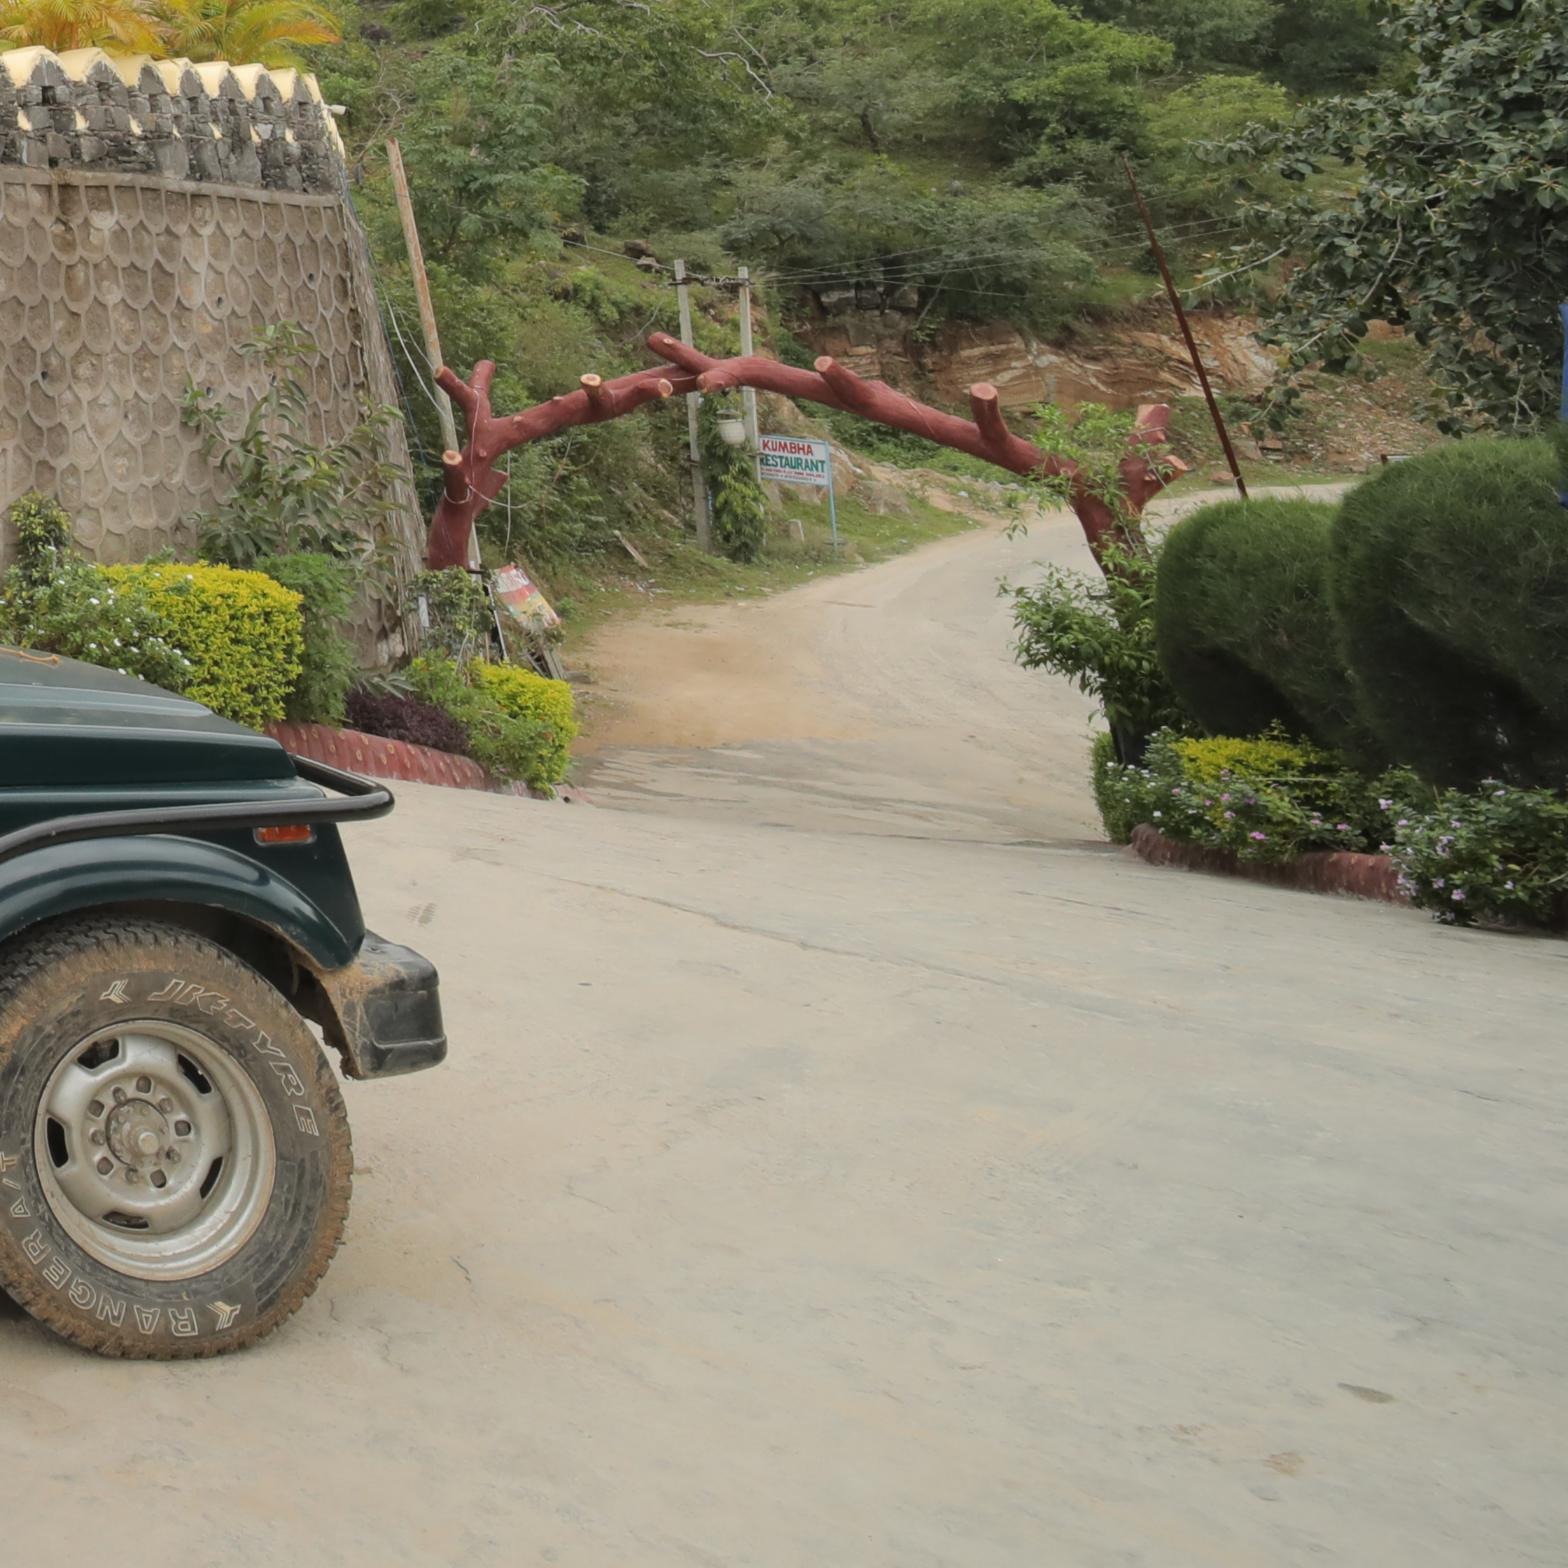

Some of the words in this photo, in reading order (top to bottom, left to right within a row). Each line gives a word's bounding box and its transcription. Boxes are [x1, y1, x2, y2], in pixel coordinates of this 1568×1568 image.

[762, 439, 813, 456] KUMBHA
[0, 1151, 31, 1218] A/T
[22, 1228, 199, 1337] RANGER
